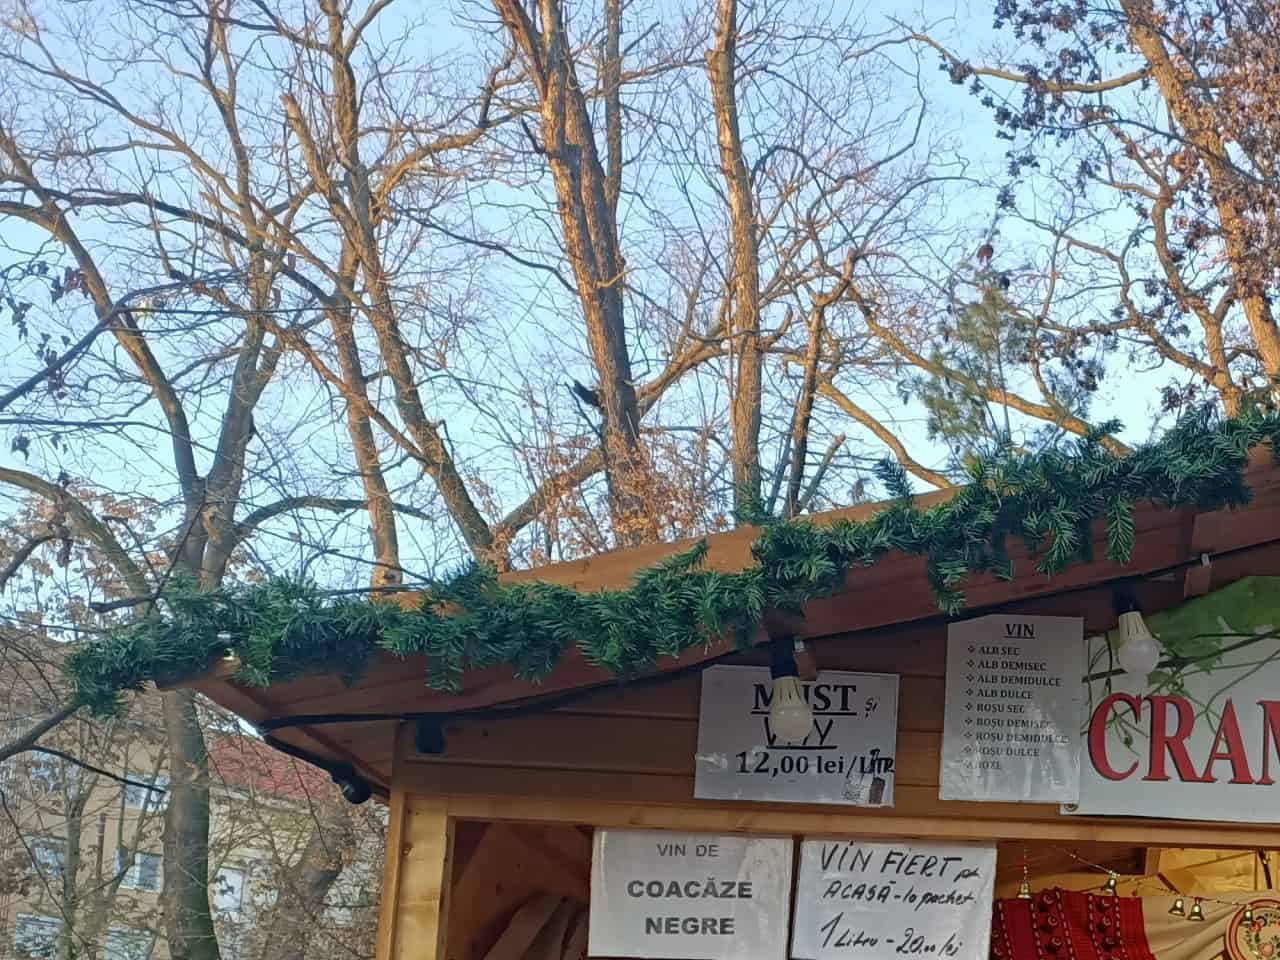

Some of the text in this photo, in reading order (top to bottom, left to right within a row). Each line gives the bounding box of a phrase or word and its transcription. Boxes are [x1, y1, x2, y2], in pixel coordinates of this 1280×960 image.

[1005, 623, 1035, 637] VIN
[978, 646, 1021, 657] ALB SEC
[978, 660, 1047, 672] ALB DEMISEC
[977, 674, 1062, 687] ALB DEMIDULCE
[976, 688, 1033, 700] ALB DULCE
[1007, 704, 1025, 714] SEC
[1006, 747, 1040, 758] DULCE
[735, 751, 810, 778] 12,00
[656, 843, 720, 858] VIN DE
[820, 840, 874, 873] VIN
[880, 848, 963, 878] FIERT
[627, 877, 753, 899] COACĂZE
[645, 916, 736, 936] NEGRE
[820, 911, 844, 950] 1
[937, 931, 963, 958] lei
